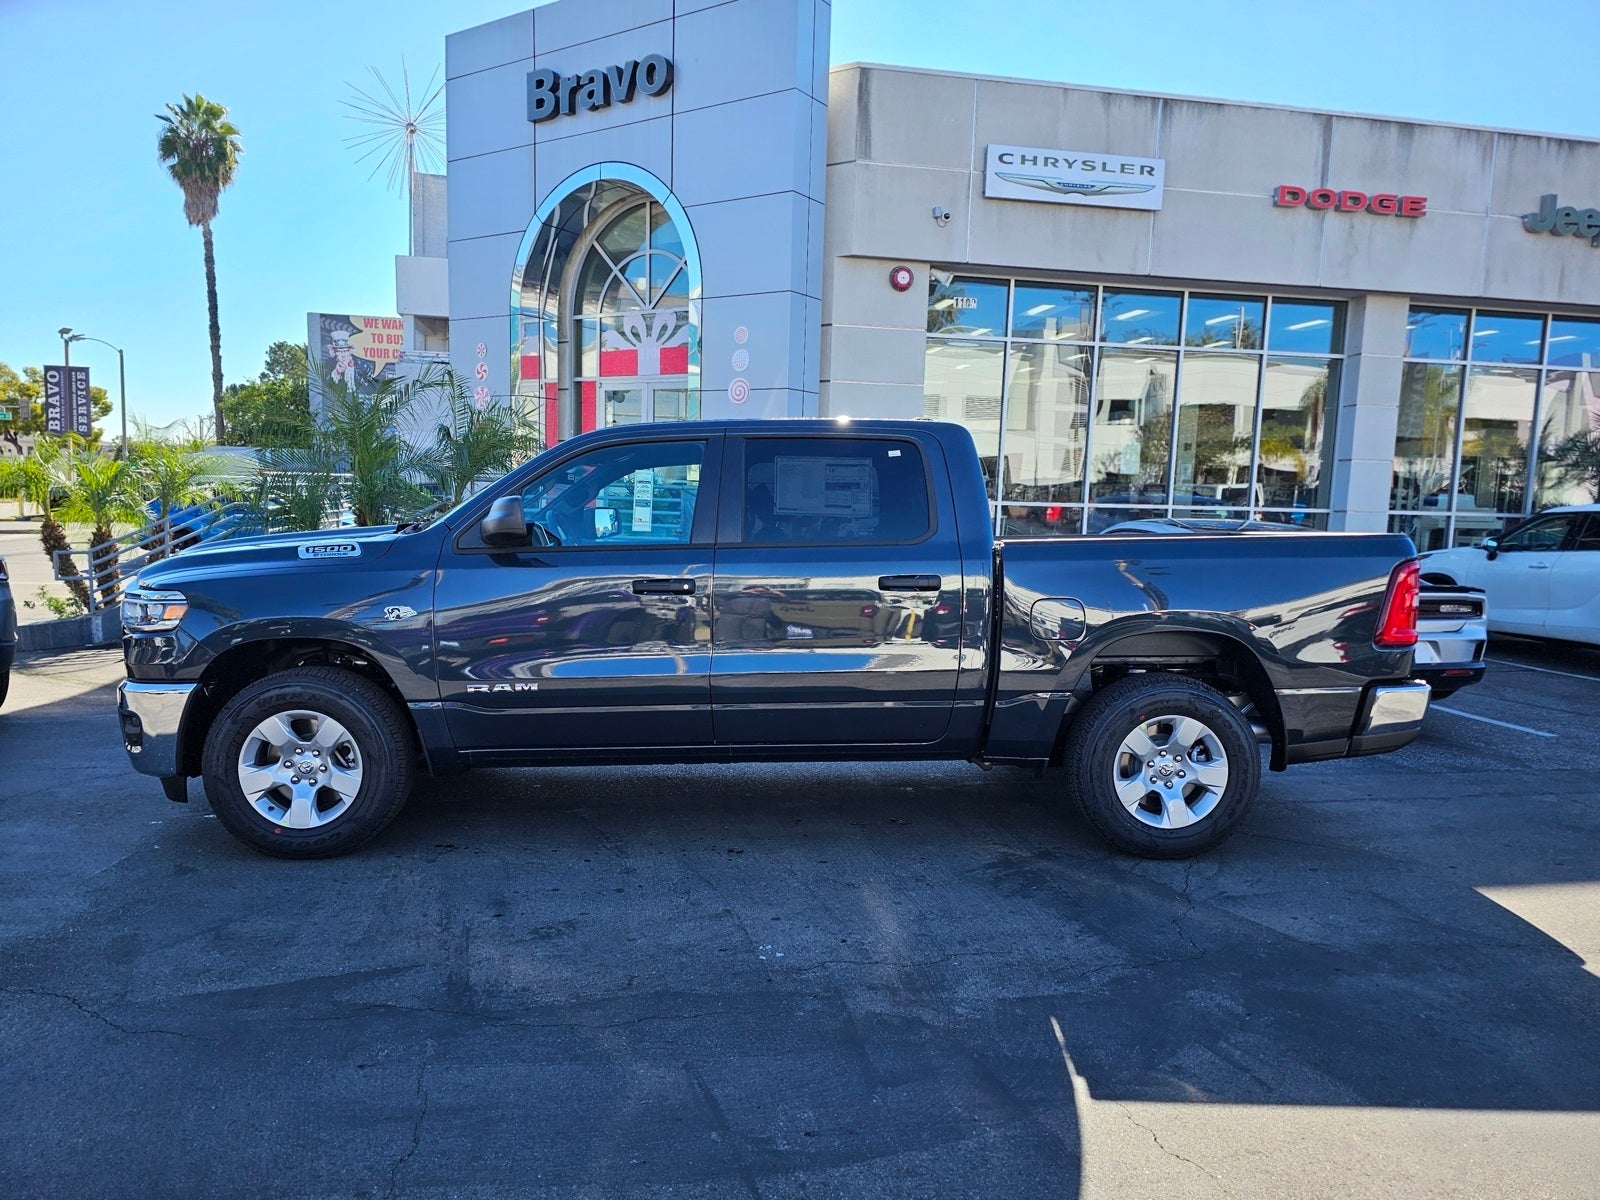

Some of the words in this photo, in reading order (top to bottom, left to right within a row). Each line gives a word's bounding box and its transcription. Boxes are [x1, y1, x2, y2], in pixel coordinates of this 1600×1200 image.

[527, 53, 674, 123] Bravo
[997, 152, 1155, 177] CHRYSLER
[1274, 185, 1428, 218] DODGE
[1521, 192, 1600, 248] Jee
[363, 317, 379, 329] WE
[371, 332, 383, 344] TO
[363, 347, 389, 359] YOUR
[47, 370, 60, 431] BRAVO
[77, 372, 87, 432] SERVICE
[307, 545, 352, 553] 1500
[466, 682, 538, 693] RAM
